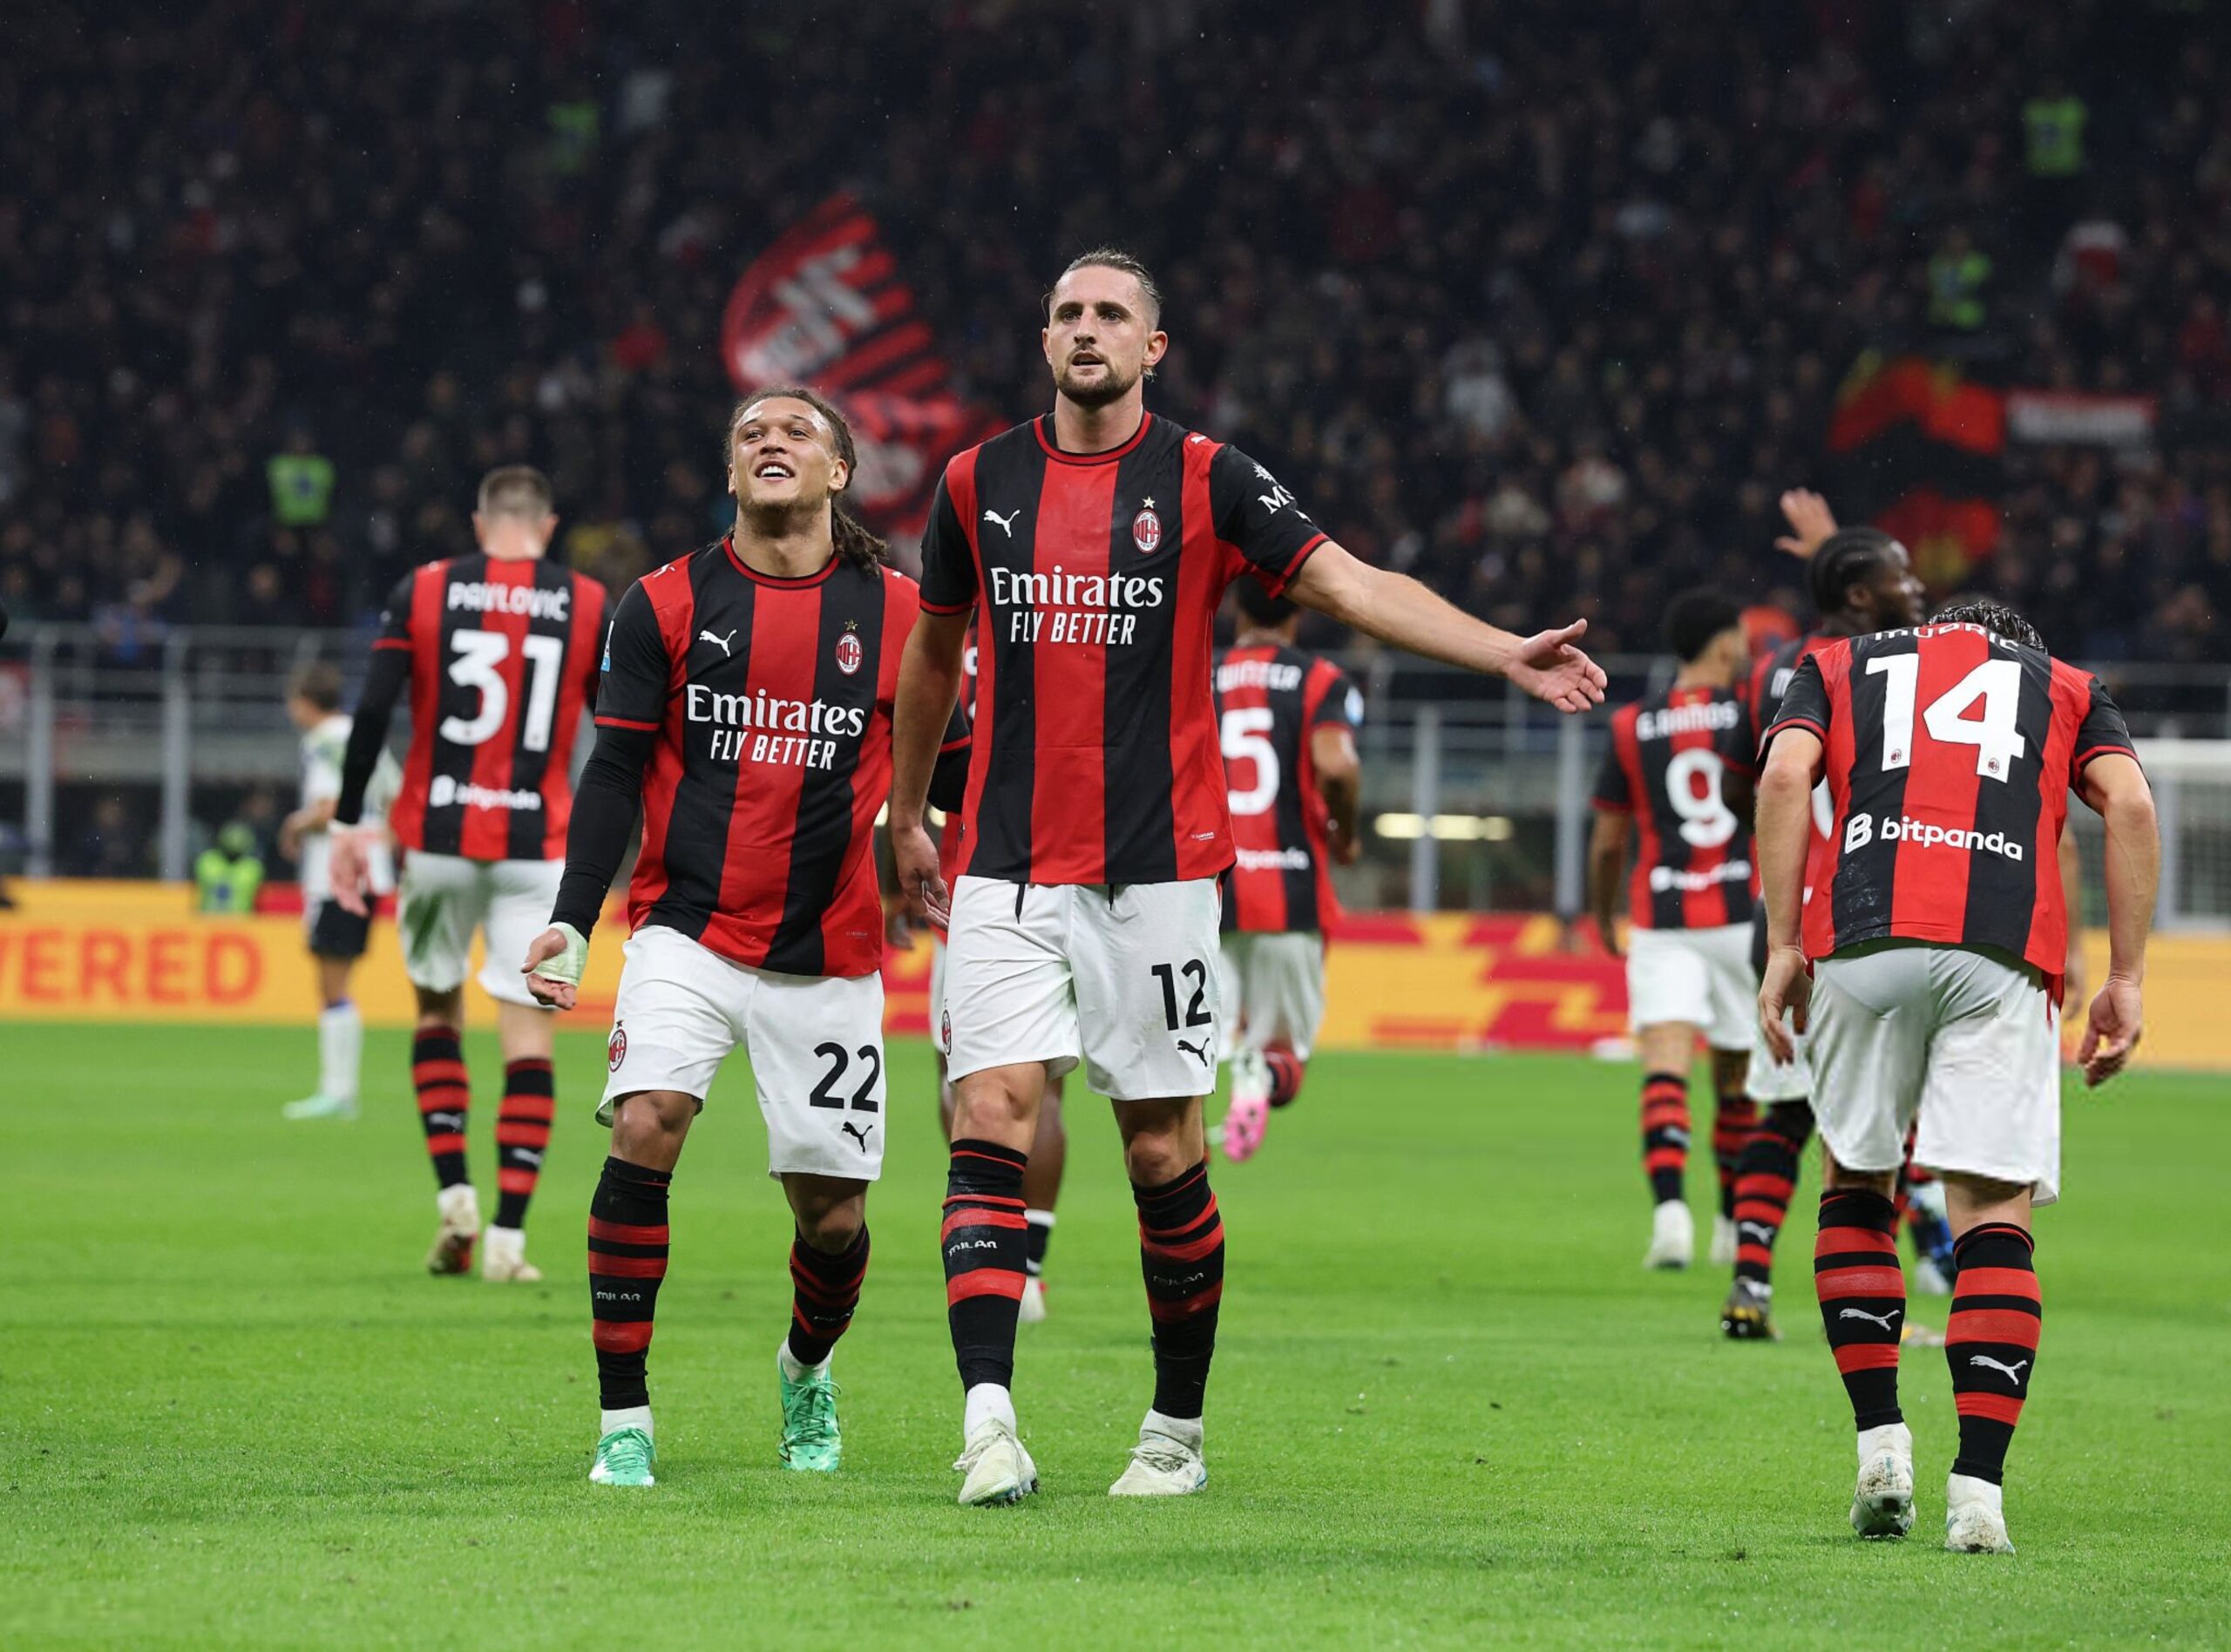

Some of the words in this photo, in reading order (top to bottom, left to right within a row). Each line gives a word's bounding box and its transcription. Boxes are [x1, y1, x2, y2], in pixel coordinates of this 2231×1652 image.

[990, 565, 1163, 607] Emirates
[1010, 612, 1045, 643] FLY
[1050, 612, 1136, 646] BETTER
[439, 628, 564, 752] 31
[687, 684, 865, 737] Emirates
[1865, 653, 2026, 783] 14
[710, 729, 749, 761] FLY
[751, 735, 837, 771] BETTER
[1221, 707, 1279, 816] 5
[1665, 748, 1738, 849] 9
[1881, 816, 2023, 861] bitpanda
[0, 927, 266, 1005] ERED
[1151, 958, 1211, 1031] 12
[810, 1042, 880, 1113] 22
